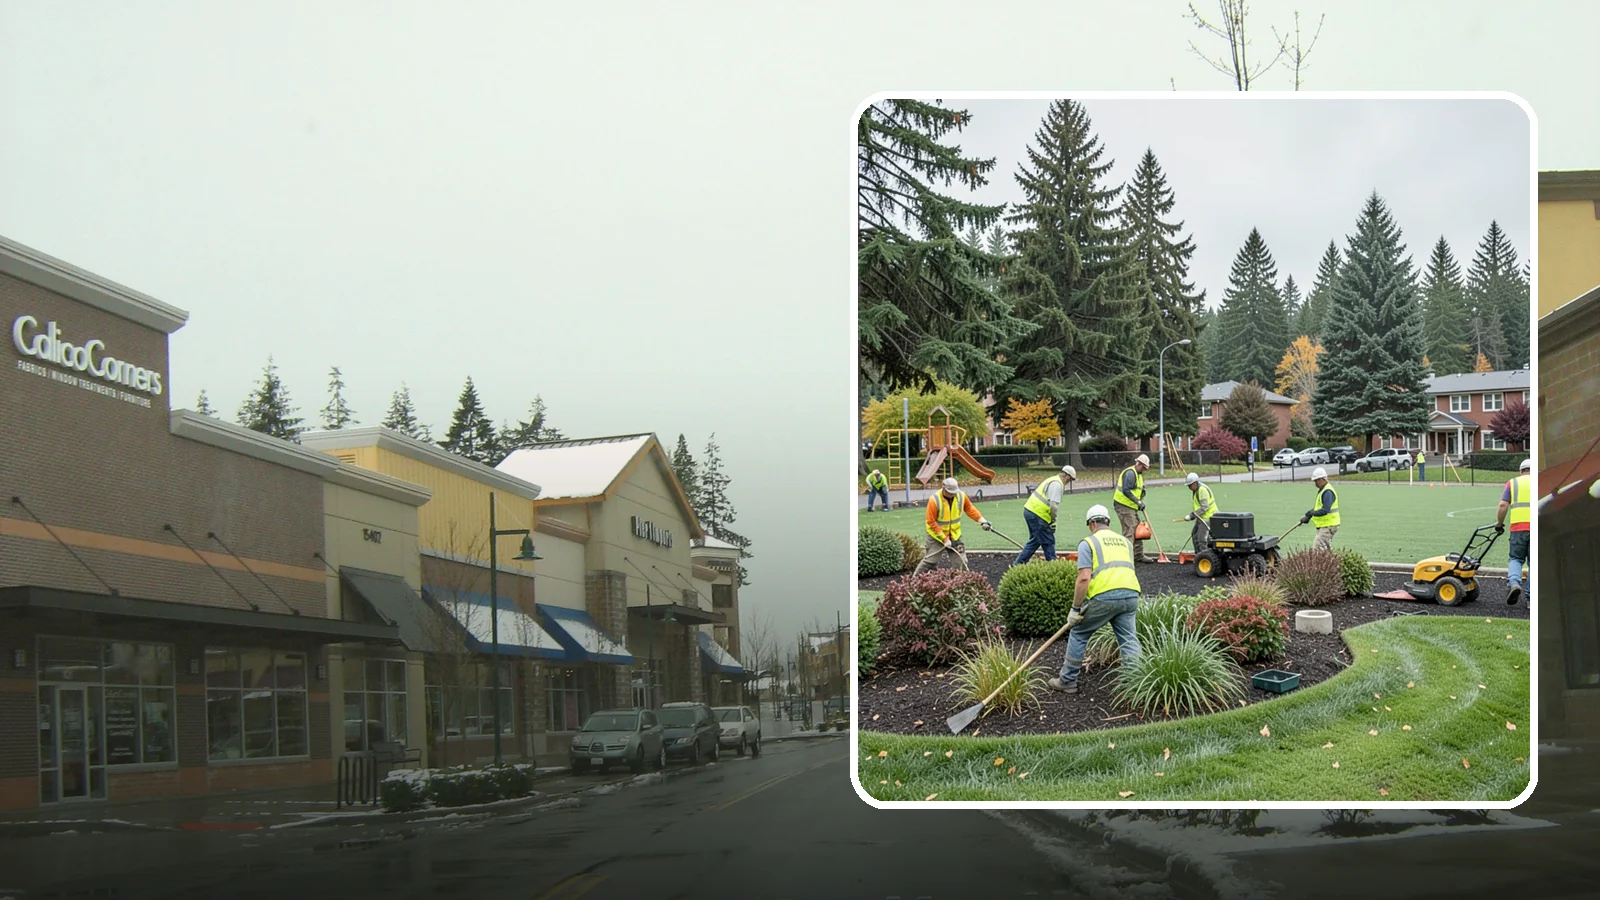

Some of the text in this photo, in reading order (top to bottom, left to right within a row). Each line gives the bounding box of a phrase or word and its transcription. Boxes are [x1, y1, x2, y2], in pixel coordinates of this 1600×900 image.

[17, 359, 47, 378] FABRICS
[51, 369, 78, 387] WINDOW
[78, 378, 117, 399] TREATMENTS
